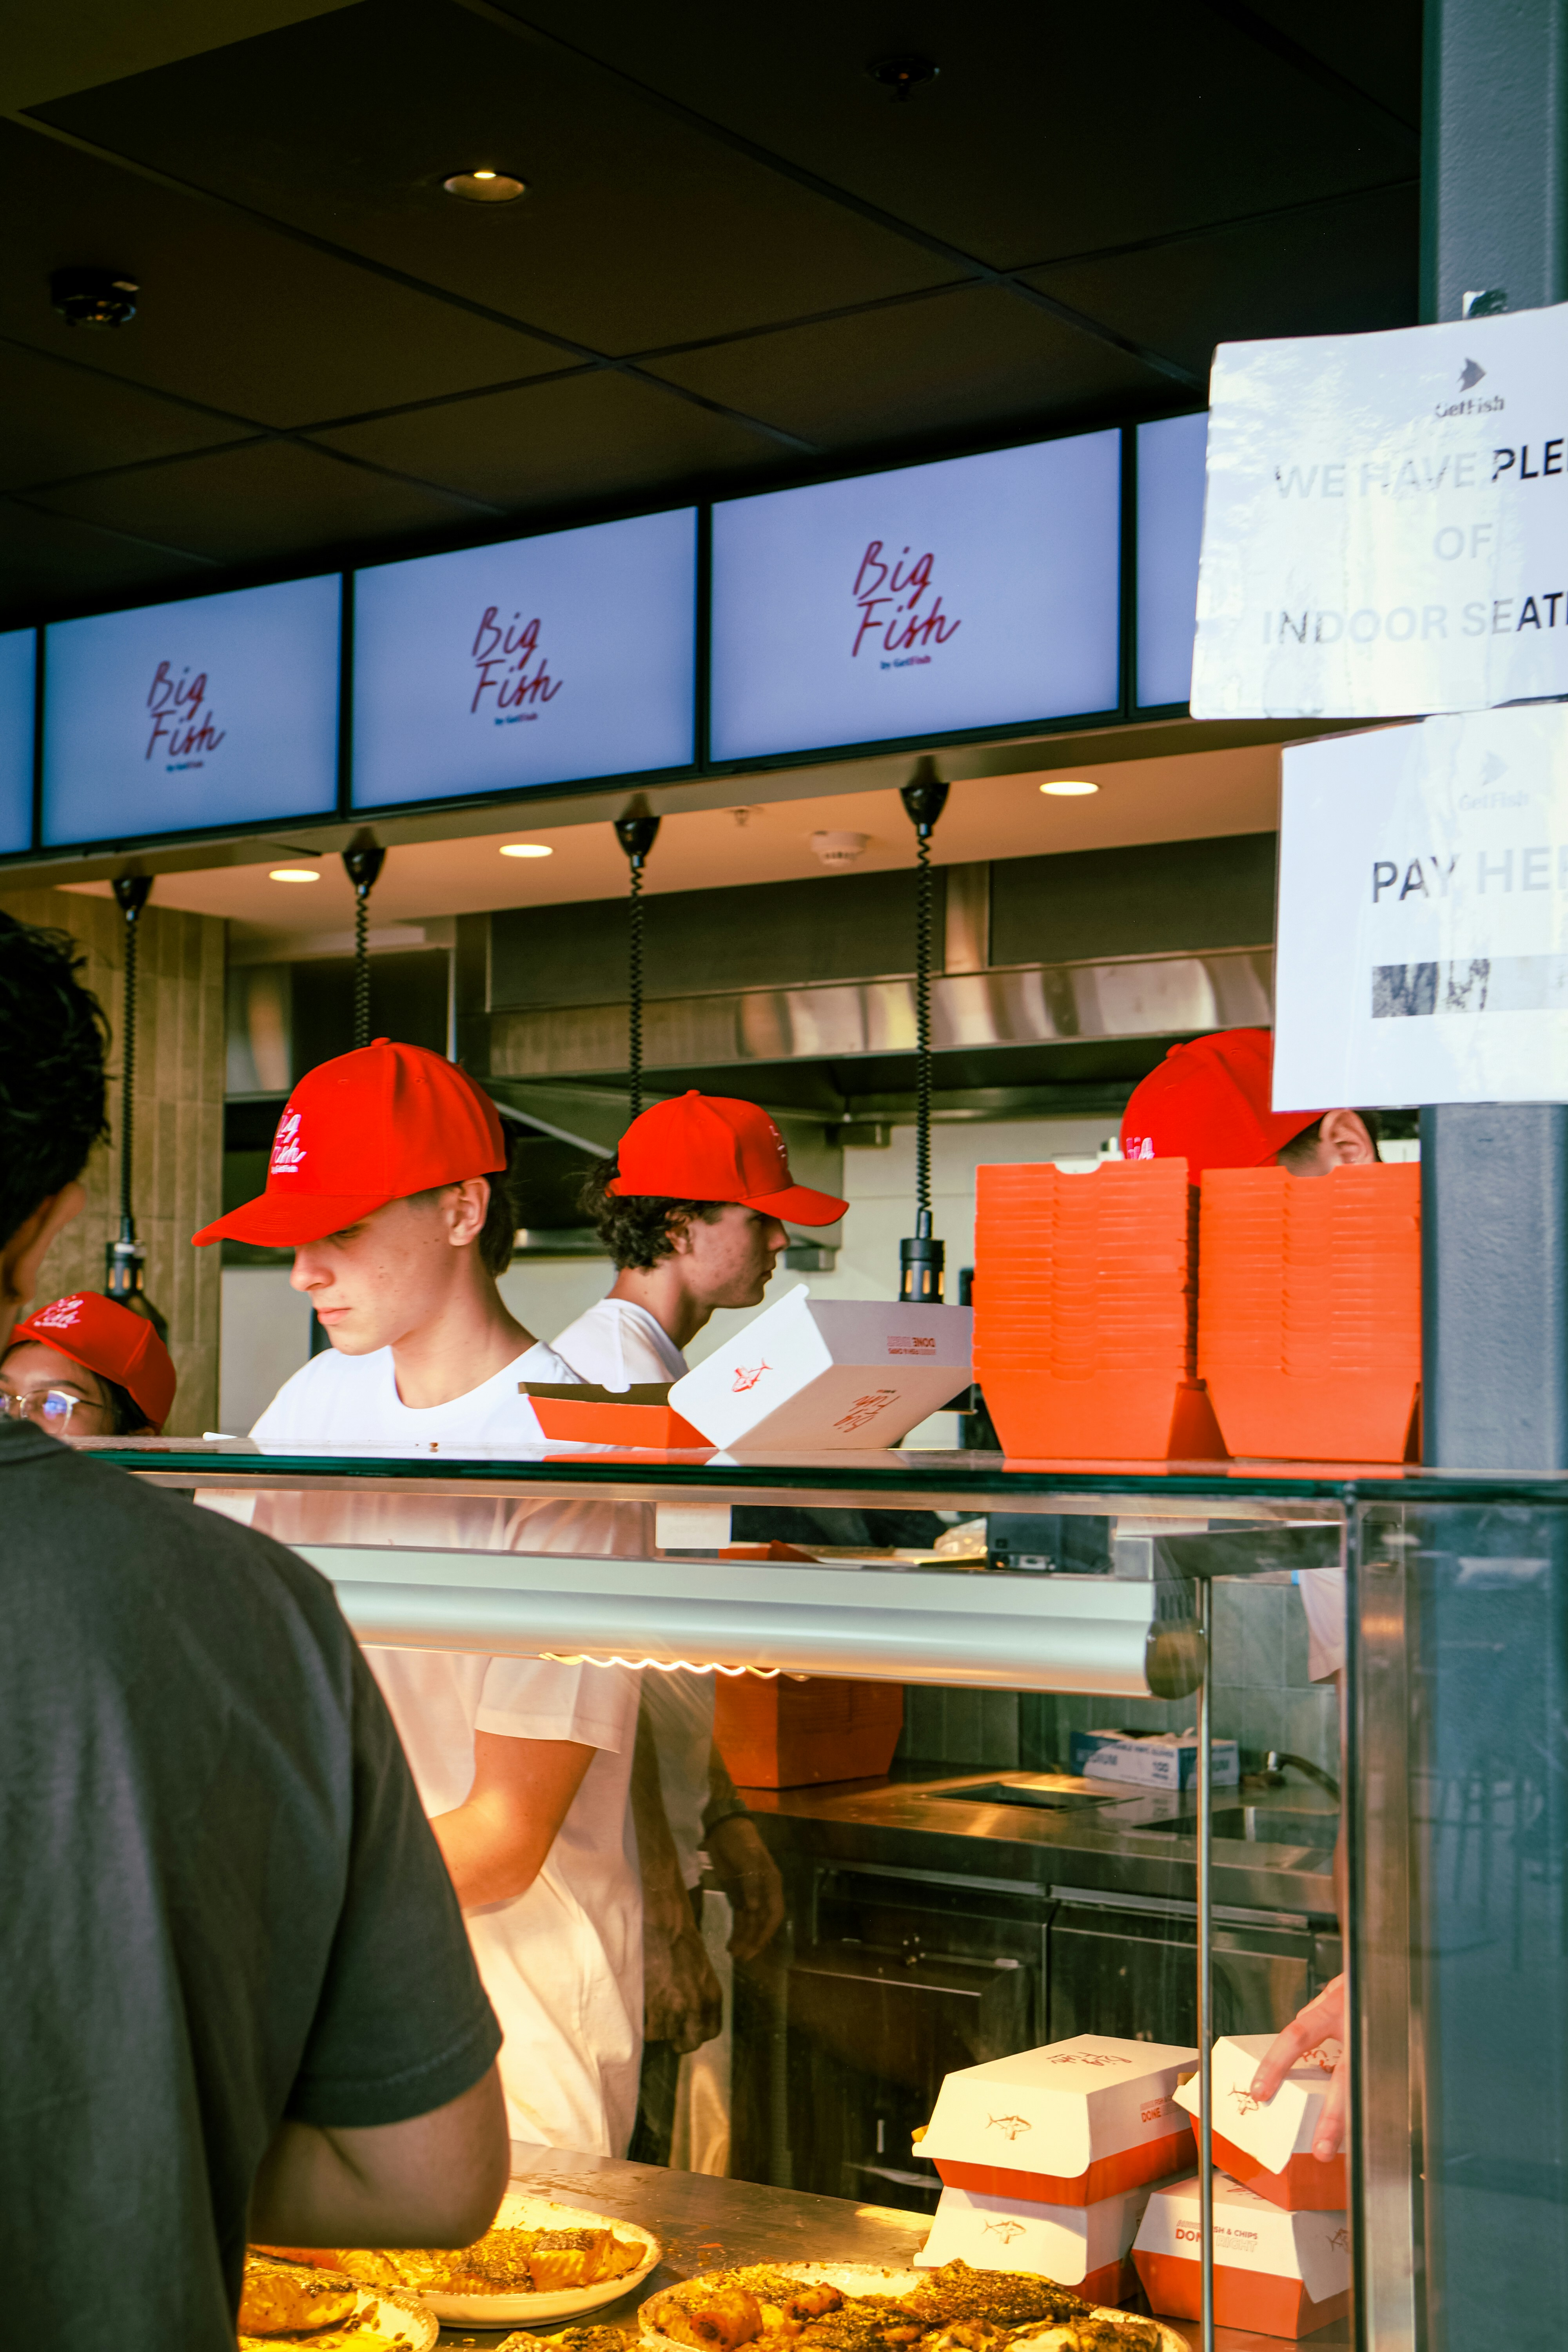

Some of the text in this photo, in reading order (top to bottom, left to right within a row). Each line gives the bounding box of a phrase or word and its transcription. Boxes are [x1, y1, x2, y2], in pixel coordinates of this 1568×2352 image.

[1275, 437, 1568, 499] WE HAVE PLE
[1433, 523, 1493, 561] OF
[852, 540, 934, 610] Big
[472, 606, 541, 670] Big
[852, 596, 962, 657] Fish
[1263, 591, 1568, 644] INDOOR SEAT
[146, 660, 207, 720] Big
[470, 658, 563, 714] Fish
[145, 710, 226, 760] Fish
[1372, 854, 1461, 903] PAY
[912, 1337, 935, 1347] DONE
[1176, 2228, 1258, 2253] DON RIGHT
[1234, 2229, 1258, 2239] CHIPS
